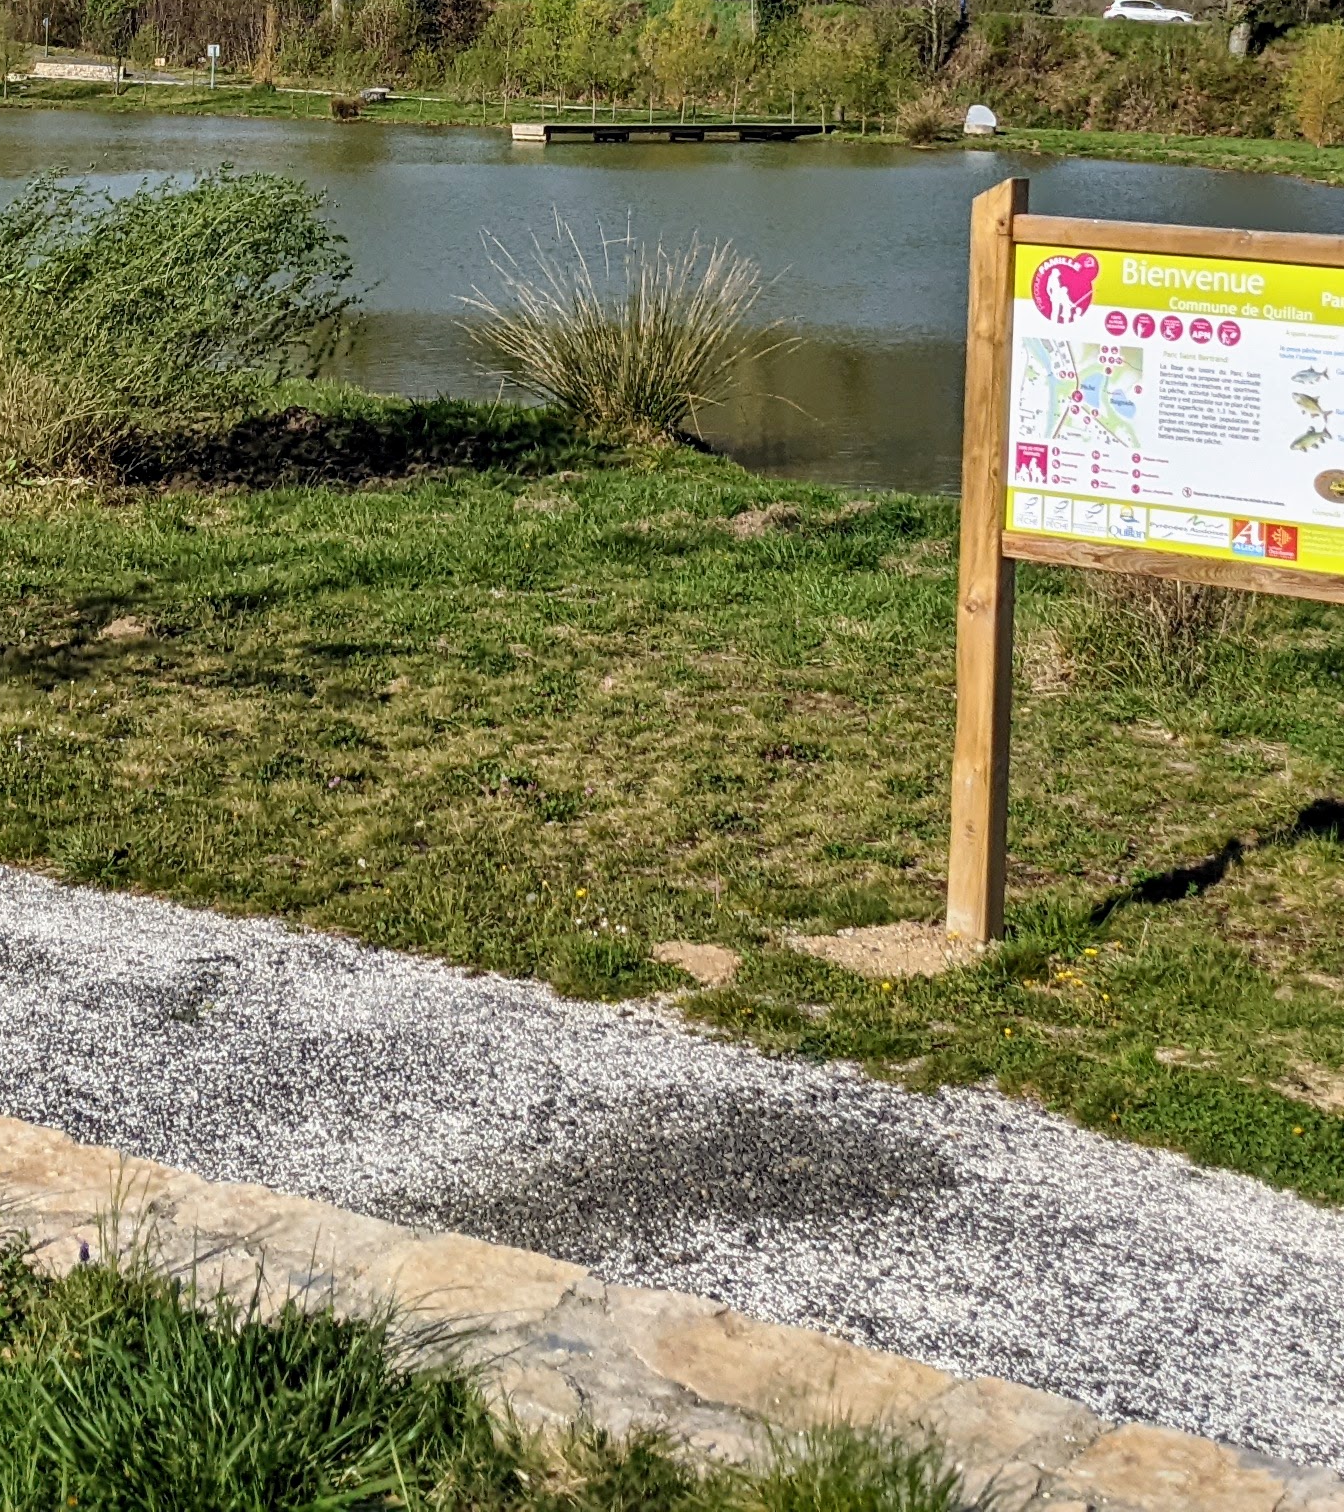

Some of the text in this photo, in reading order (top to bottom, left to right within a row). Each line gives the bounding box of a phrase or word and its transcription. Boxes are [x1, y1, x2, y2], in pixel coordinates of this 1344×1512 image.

[1122, 258, 1264, 295] Bienvenue
[1169, 297, 1313, 321] Commune de Quillan
